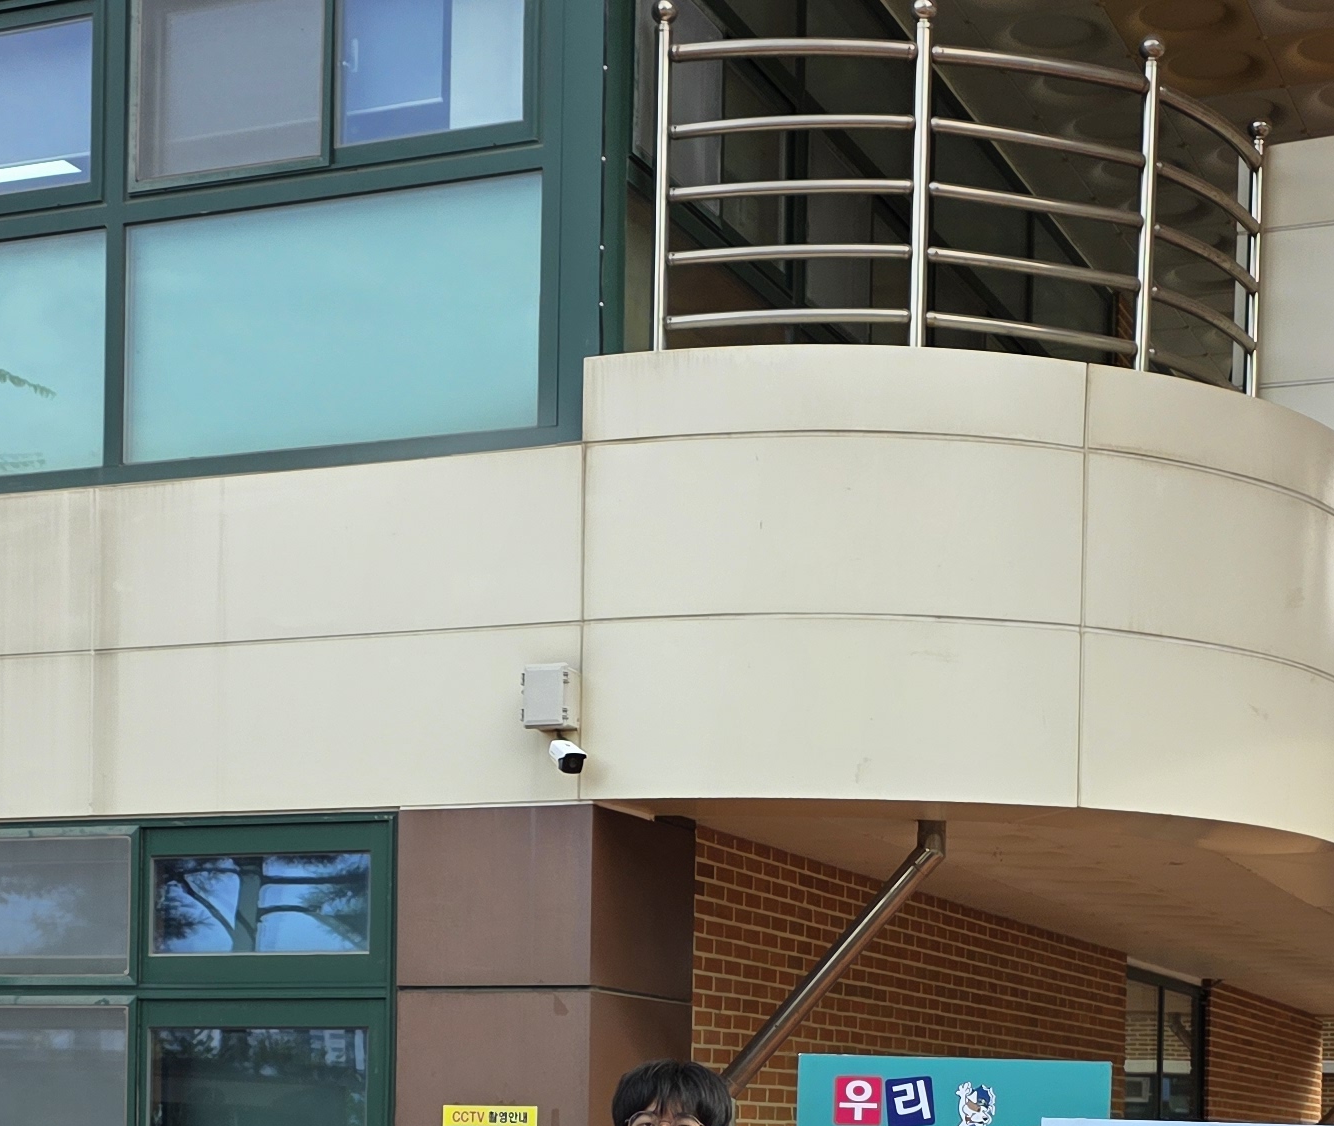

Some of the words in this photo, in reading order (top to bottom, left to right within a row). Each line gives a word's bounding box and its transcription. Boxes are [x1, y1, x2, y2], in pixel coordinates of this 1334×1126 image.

[839, 1080, 931, 1120] 우리
[452, 1111, 485, 1123] CCTV
[488, 1111, 528, 1124] 촬영안내
